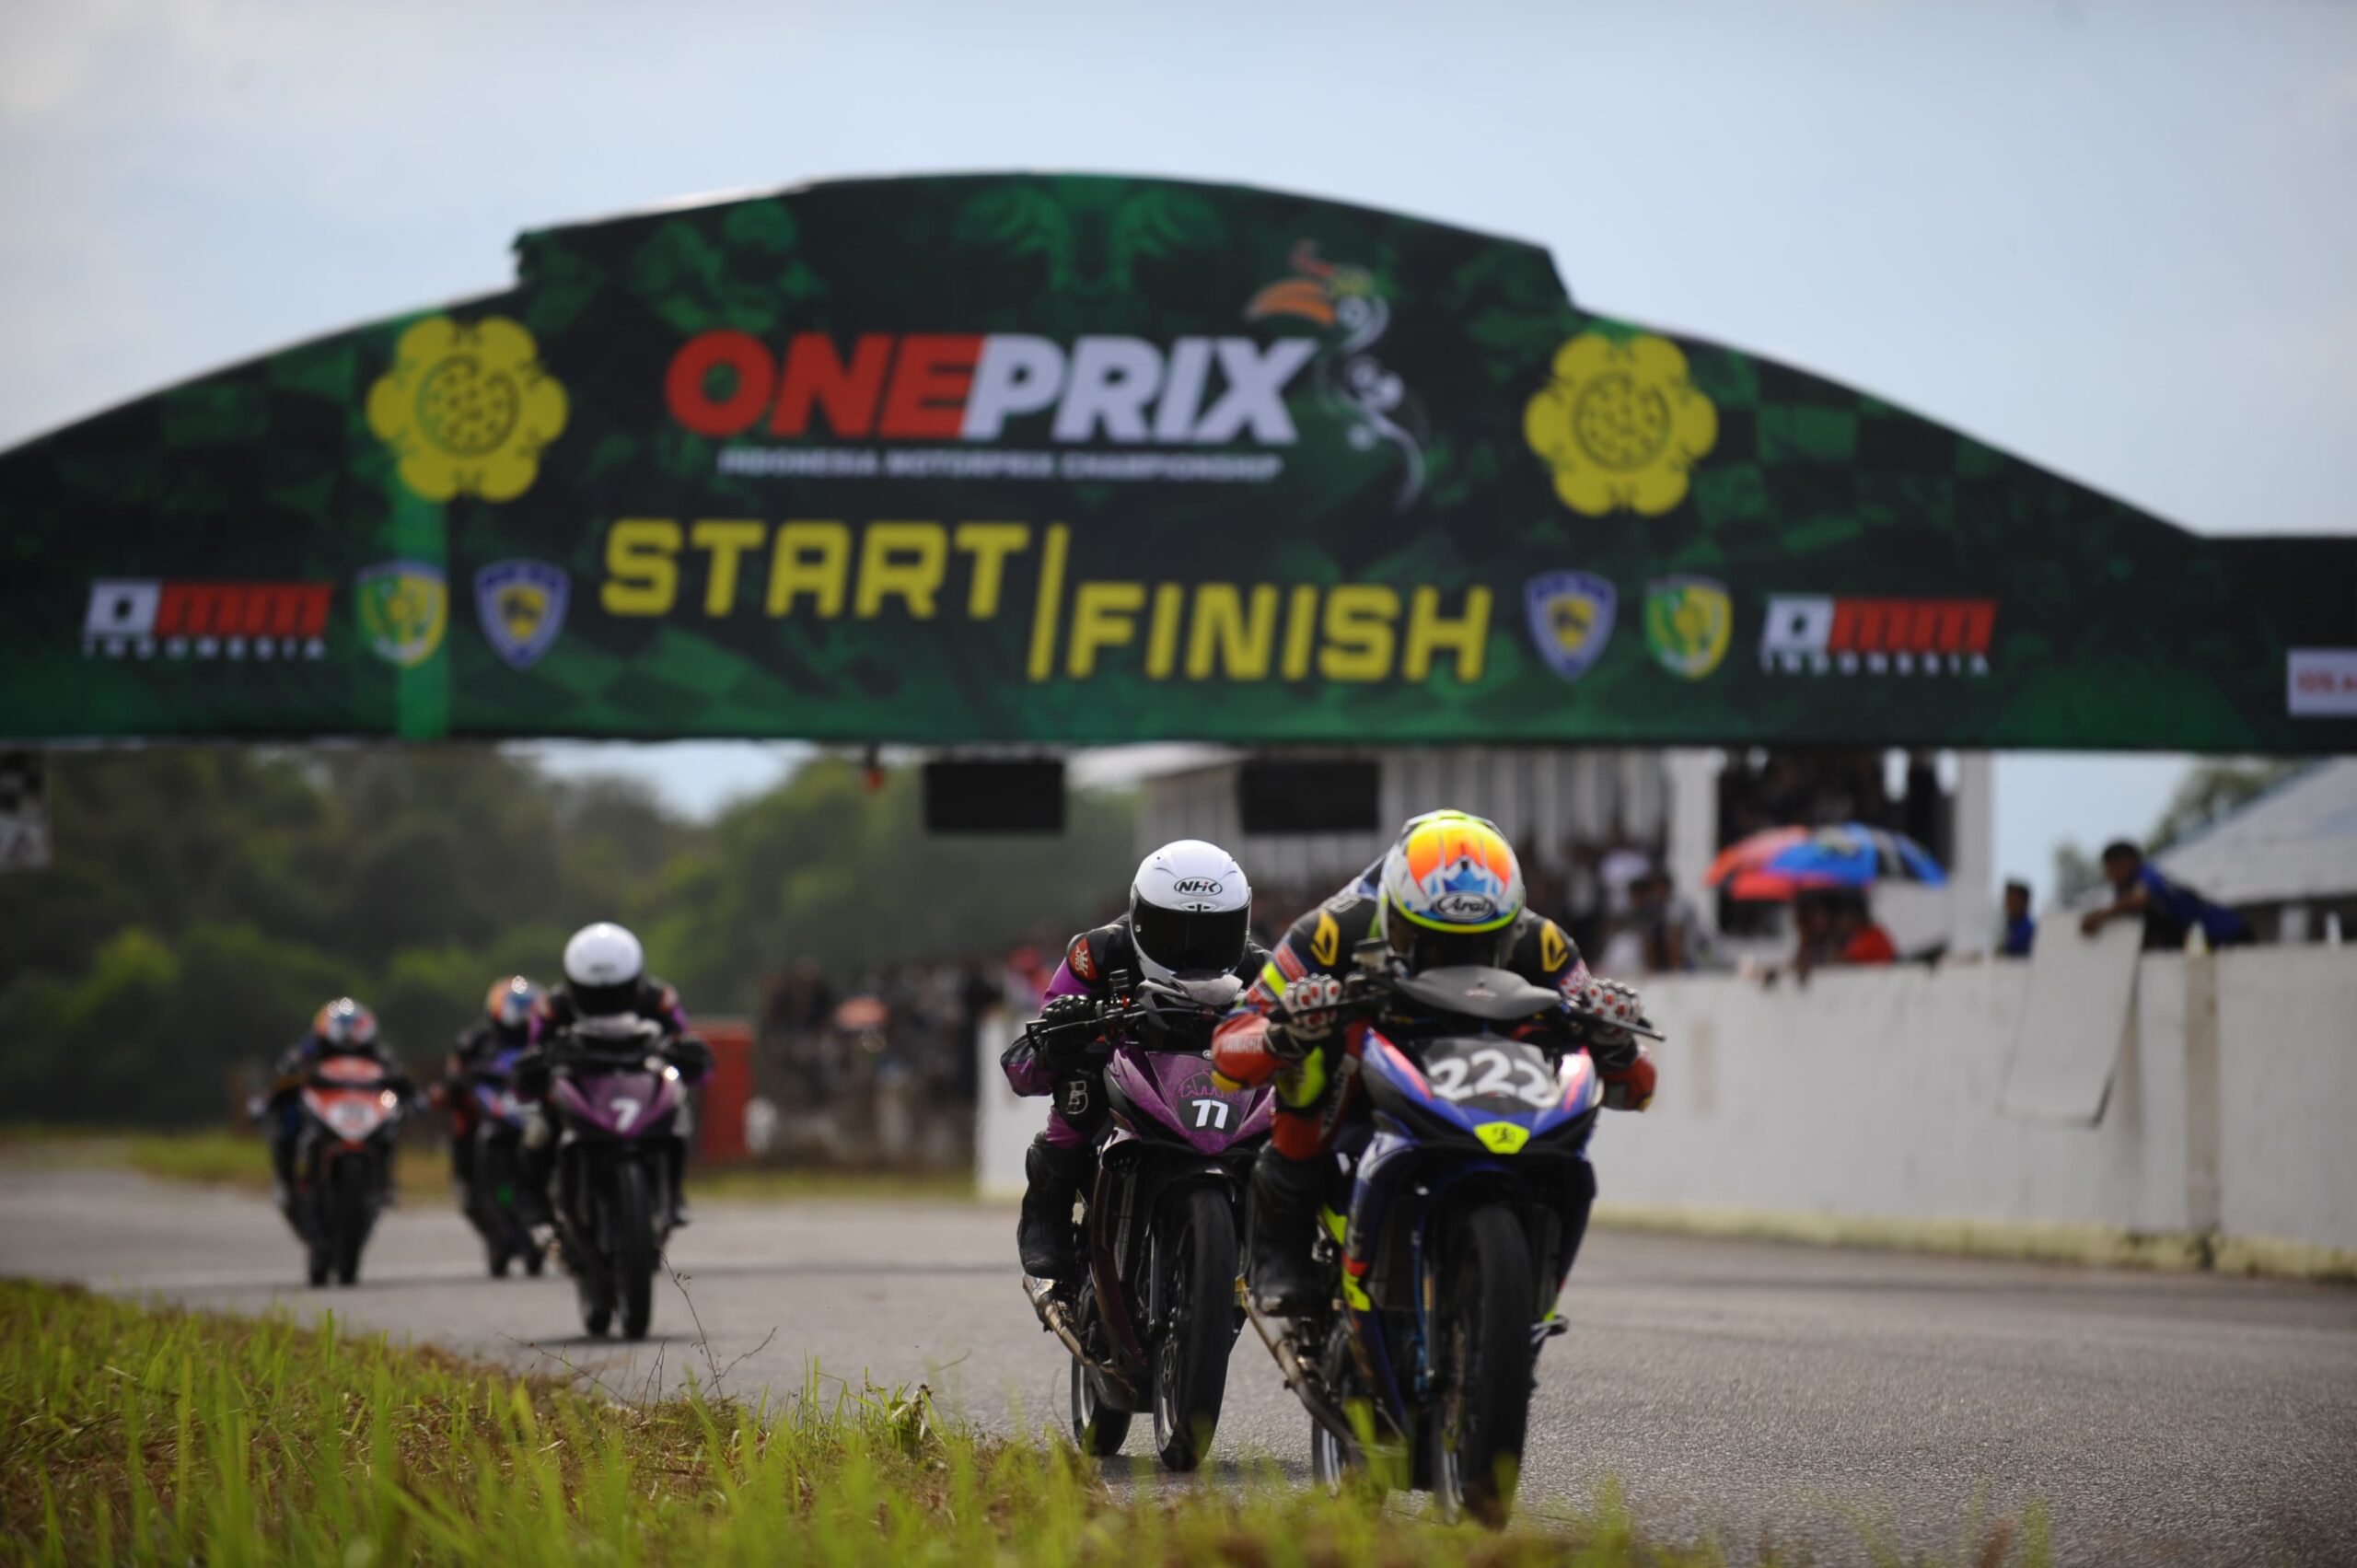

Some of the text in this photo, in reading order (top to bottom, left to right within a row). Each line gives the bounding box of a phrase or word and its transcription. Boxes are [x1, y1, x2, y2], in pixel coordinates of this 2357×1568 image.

[664, 329, 1320, 444] ONEPRIX
[601, 517, 1492, 682] START FINISH
[1759, 648, 1990, 676] INDONESIA
[1178, 880, 1219, 893] NHK
[1429, 1049, 1560, 1108] 222
[610, 1099, 640, 1132] 7
[1191, 1098, 1229, 1130] 77
